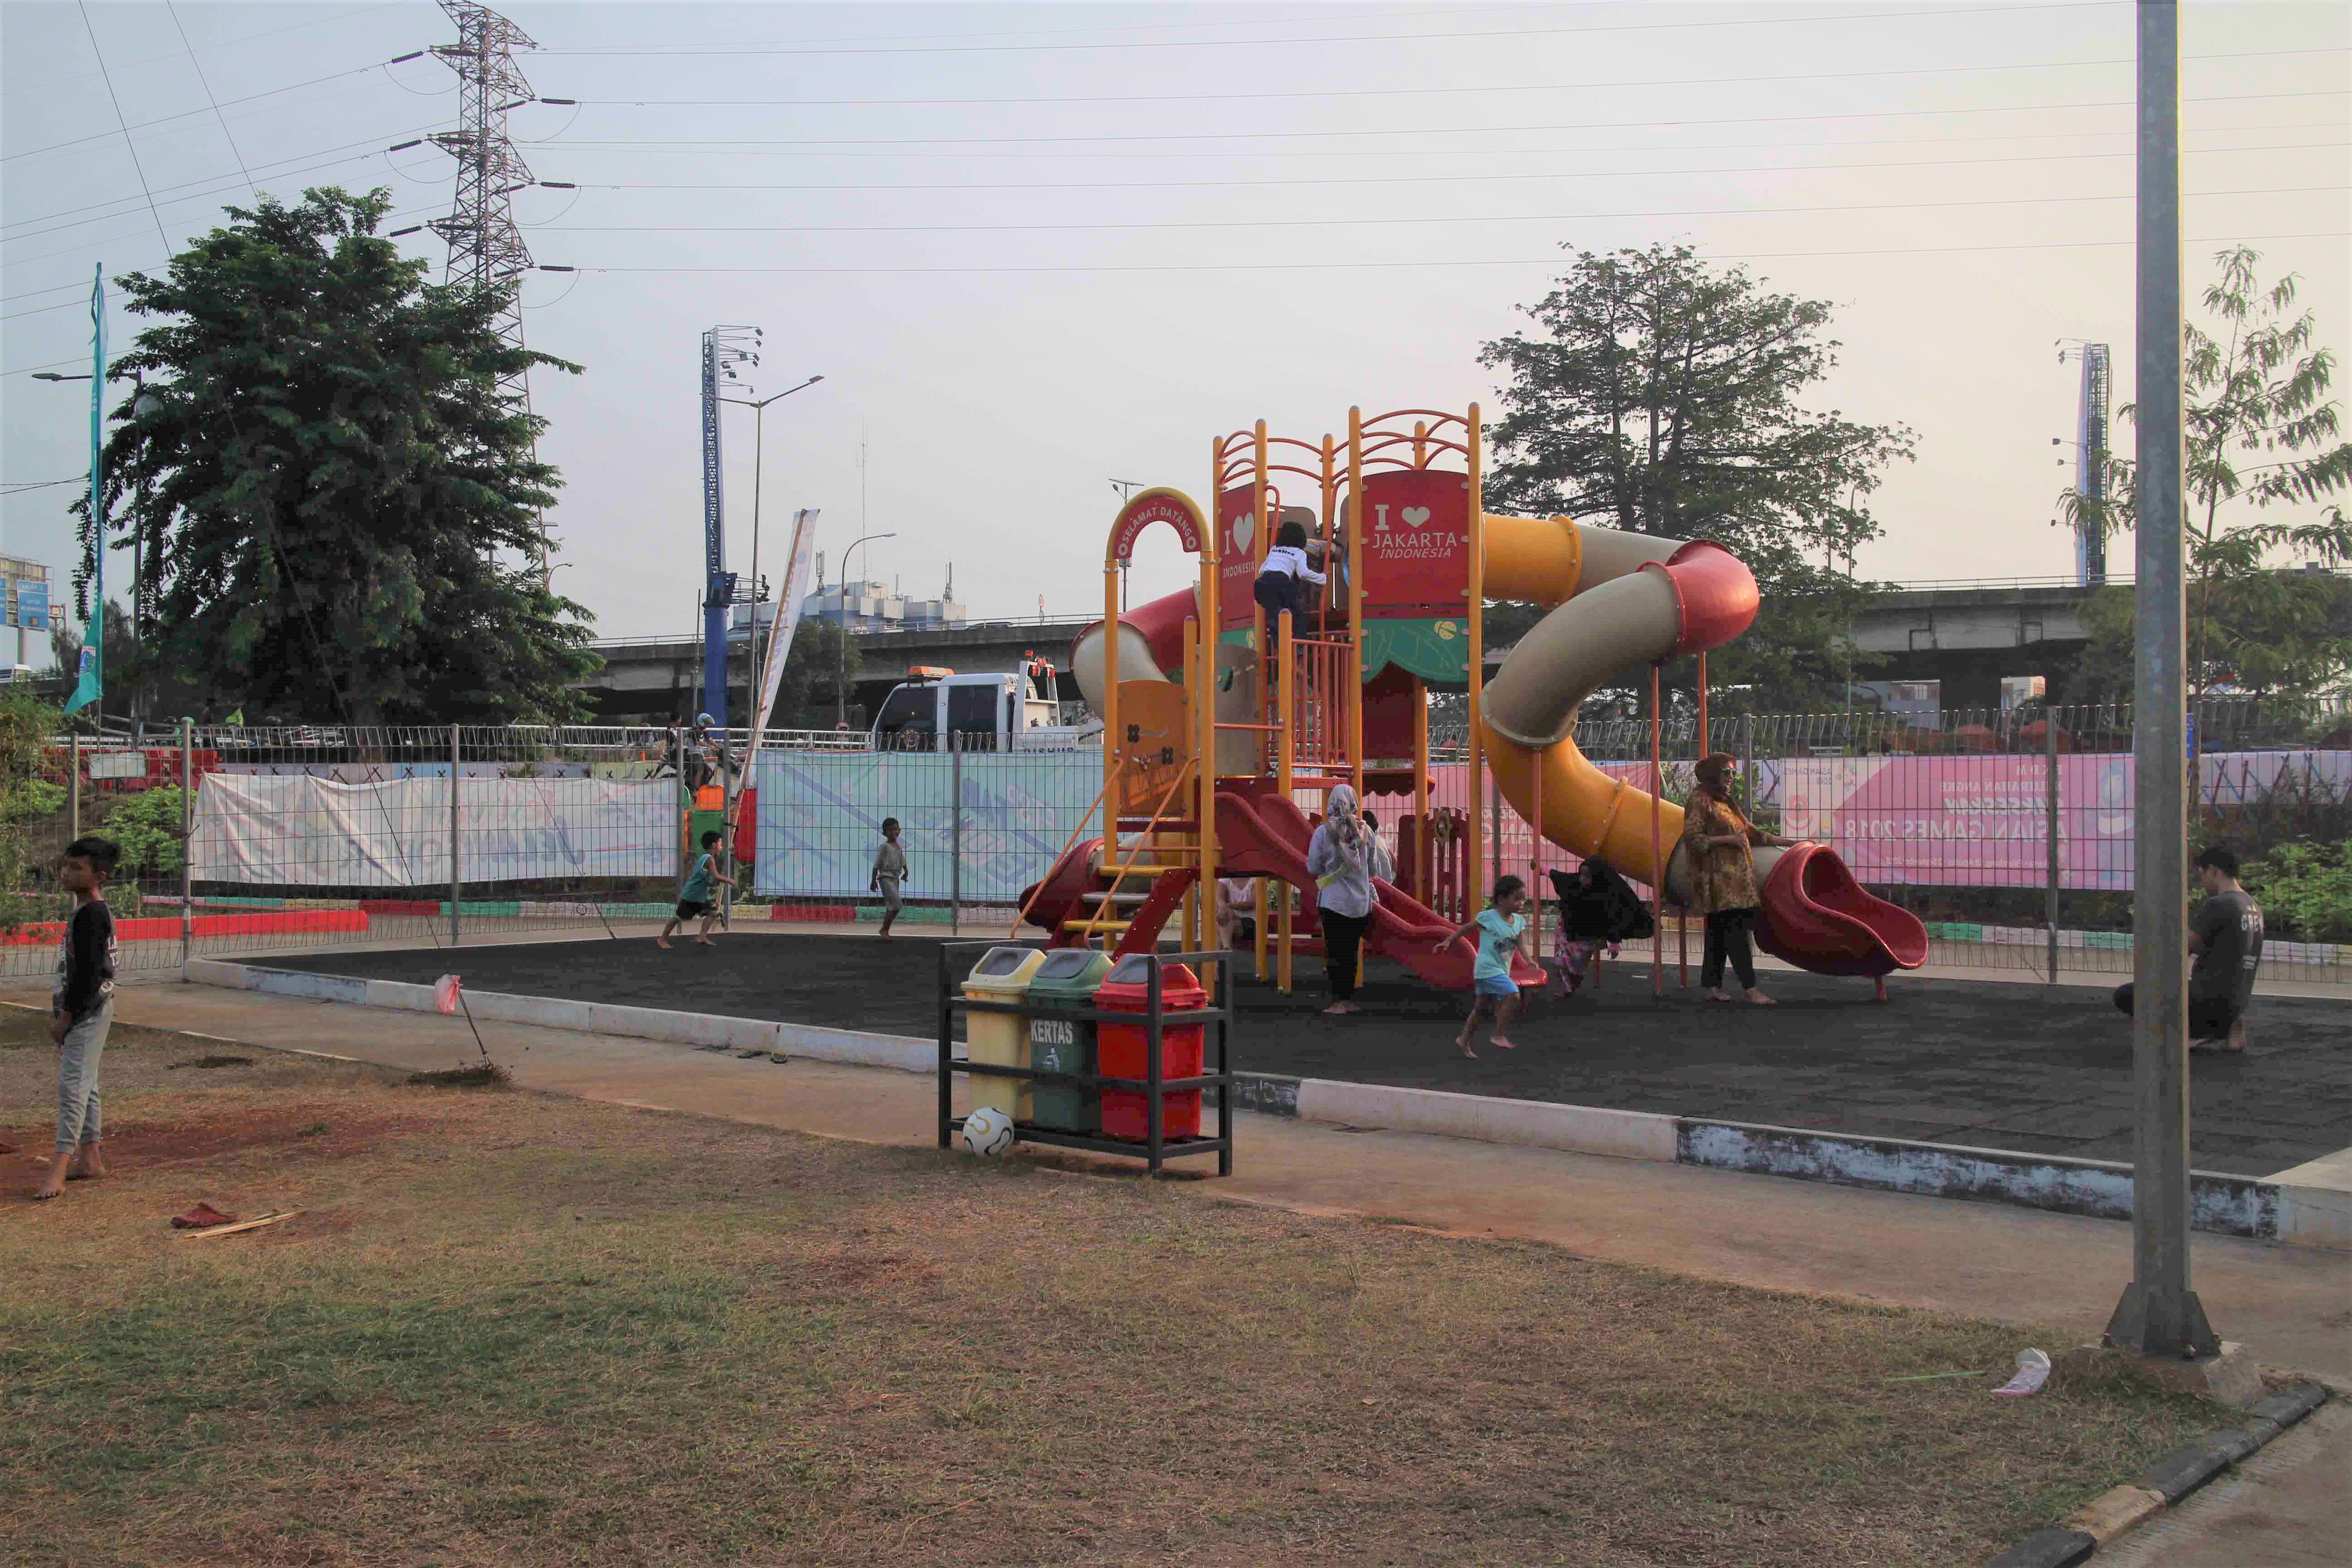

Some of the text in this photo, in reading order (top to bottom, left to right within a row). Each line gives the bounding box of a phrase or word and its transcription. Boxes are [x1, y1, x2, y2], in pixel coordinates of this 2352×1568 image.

[1122, 506, 1192, 544] SELAMAT DATANG
[1374, 504, 1390, 530] I
[1224, 529, 1231, 555] I
[1372, 532, 1458, 548] JAKARTA
[1379, 548, 1452, 559] INDONESIA
[1223, 560, 1255, 579] INDONESIA
[1030, 1019, 1073, 1045] KERTAS
